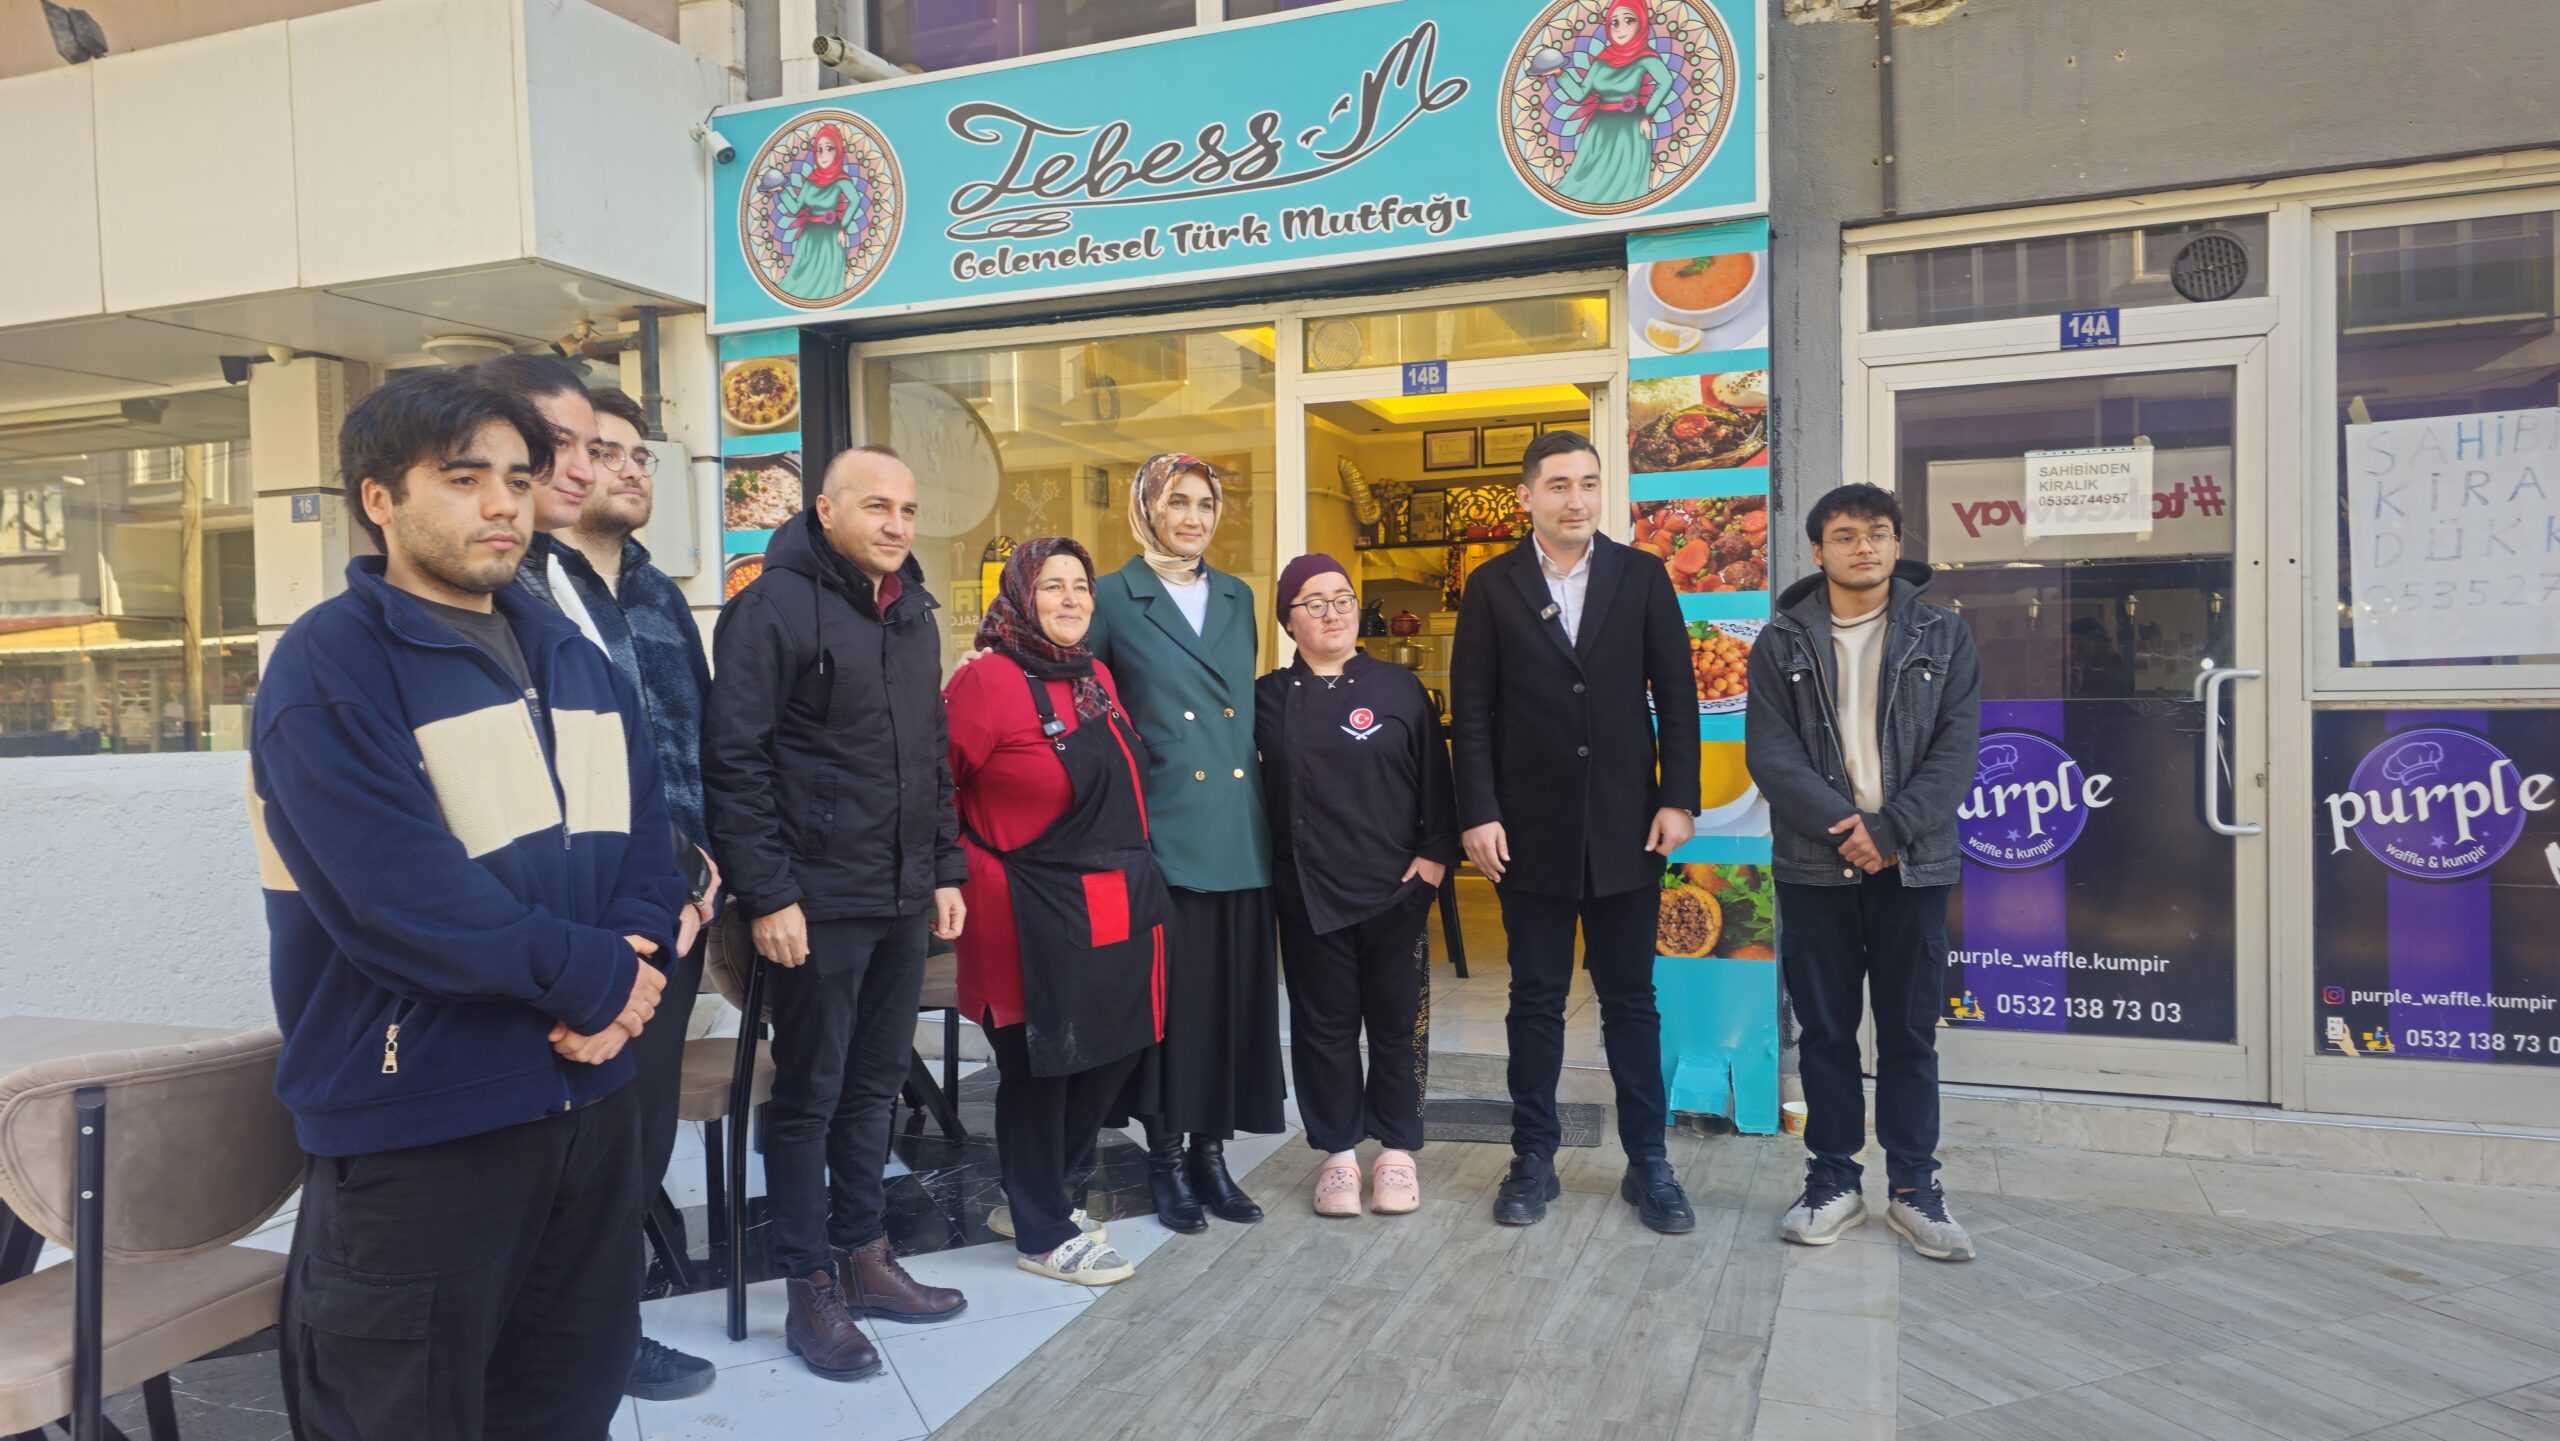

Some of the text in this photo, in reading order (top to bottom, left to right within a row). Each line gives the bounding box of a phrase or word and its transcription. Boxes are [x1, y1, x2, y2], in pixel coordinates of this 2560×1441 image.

[953, 194, 1469, 281] Geleneksel Türk Mutfağı
[2068, 315, 2111, 338] 14A
[1408, 366, 1440, 386] 14B
[2039, 462, 2131, 478] SAHİBİNDEN
[2039, 479, 2099, 493] KİRALIK
[2374, 466, 2547, 519] KİRA
[298, 499, 312, 514] 16
[2038, 492, 2129, 507] 05352744957
[1957, 760, 2114, 839] urple
[2324, 758, 2556, 855] purple
[1968, 836, 2056, 859] waffle & kumpir
[2385, 843, 2488, 869] waffle & kumpir
[1947, 948, 2170, 976] purple_waffle.kumpir
[1996, 993, 2182, 1023] 0532 138 73 03
[2351, 989, 2557, 1013] purple_waffle.kumpir
[2406, 1029, 2462, 1049] 0532
[2468, 1032, 2506, 1051] 138
[2513, 1034, 2541, 1053] 73
